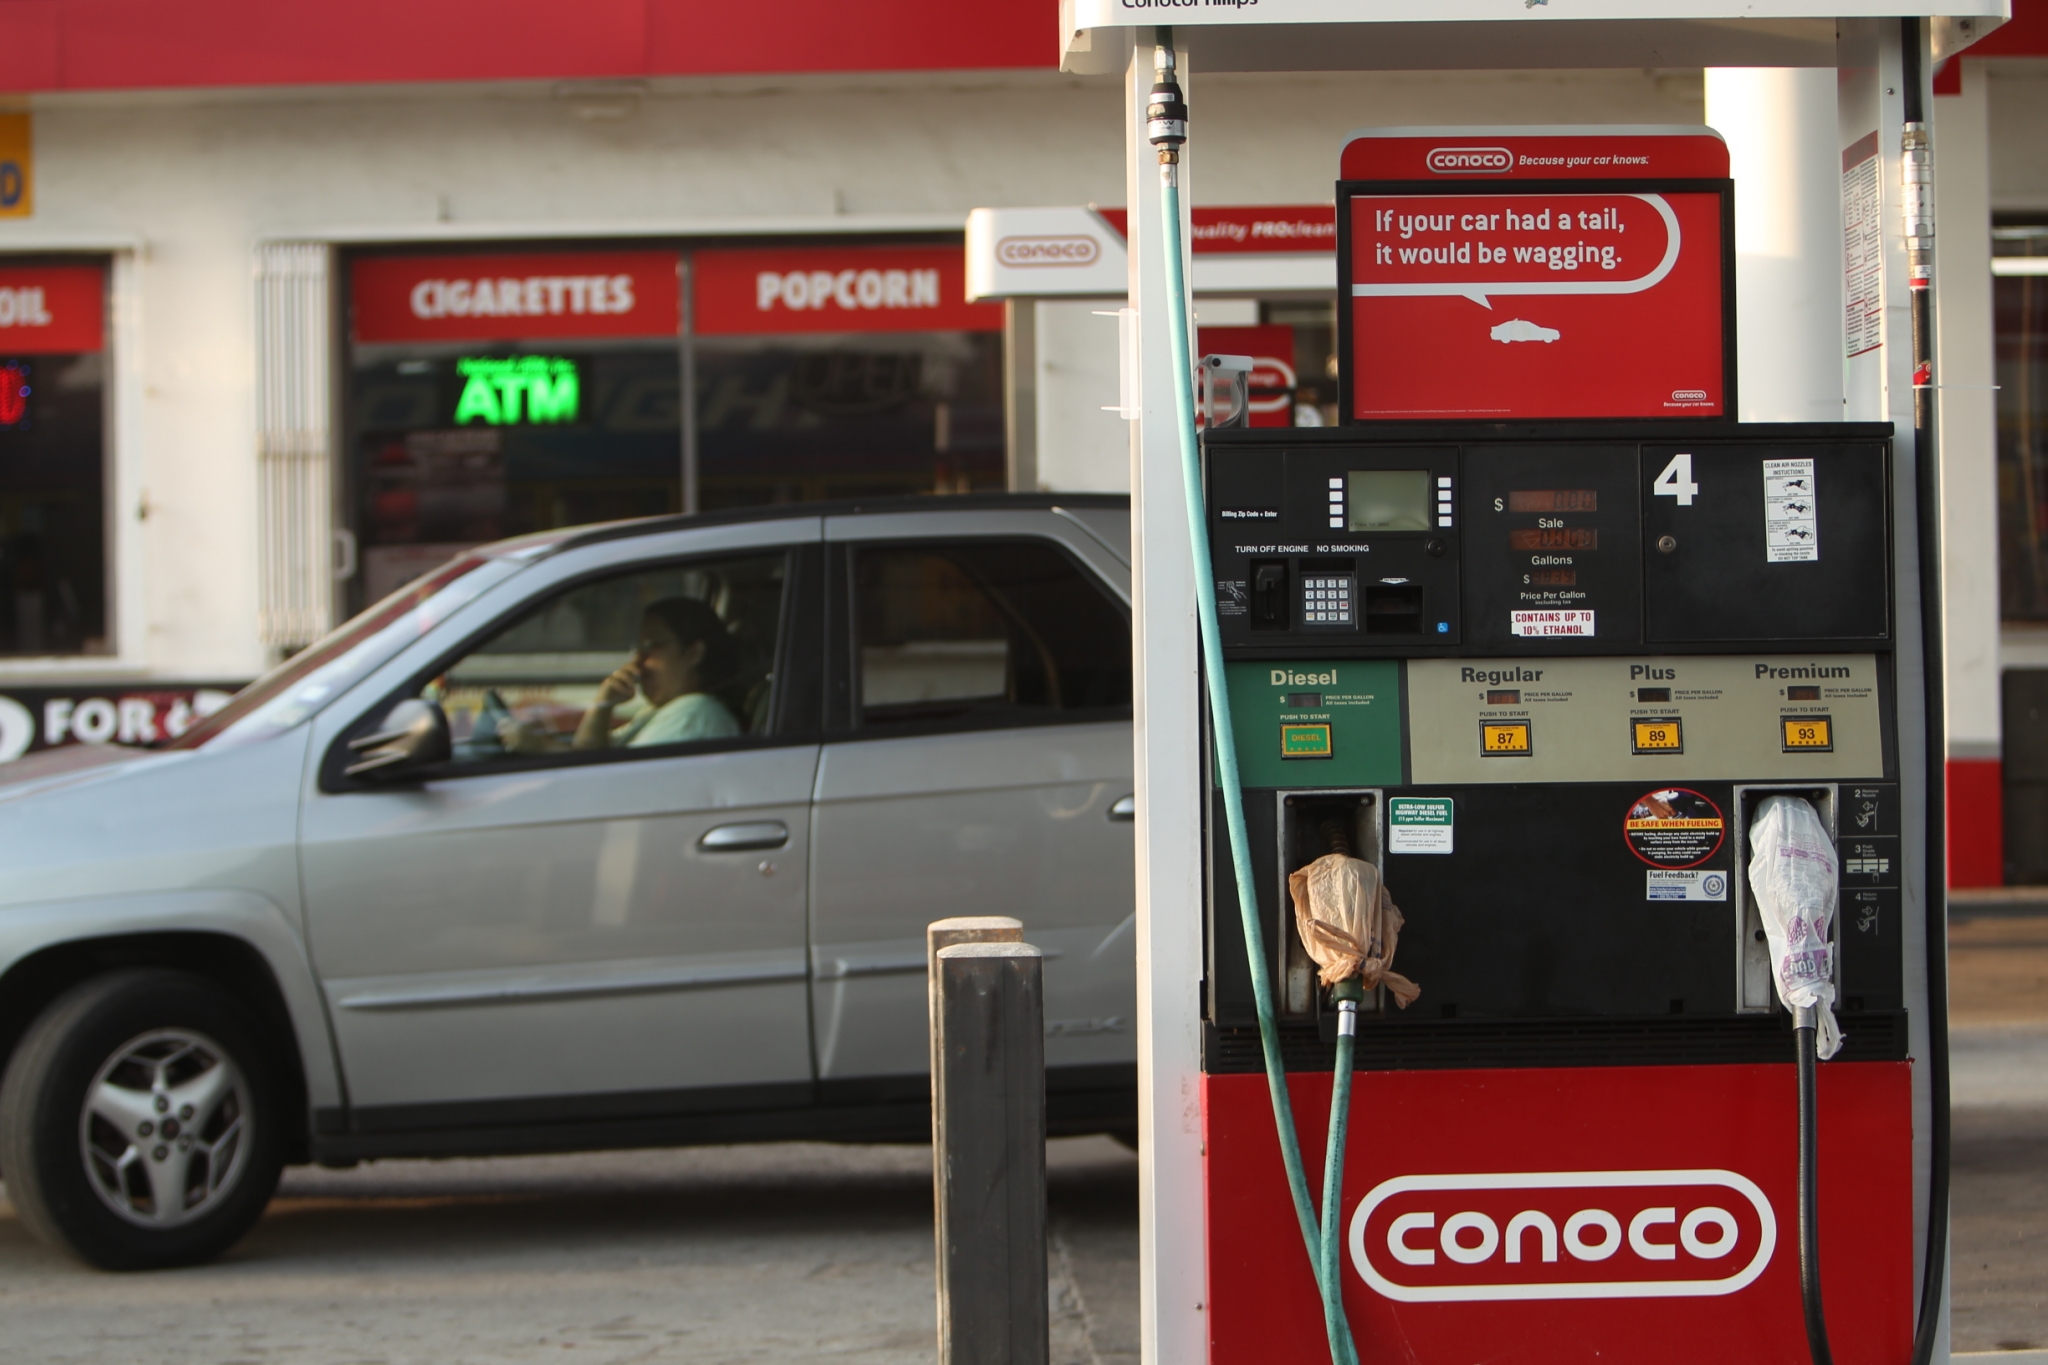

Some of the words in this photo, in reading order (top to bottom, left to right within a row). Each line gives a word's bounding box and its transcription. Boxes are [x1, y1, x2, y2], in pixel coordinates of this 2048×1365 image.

[1519, 155, 1564, 166] Because
[1567, 156, 1592, 168] your
[1594, 156, 1611, 165] car
[1613, 155, 1649, 165] knows.
[1376, 210, 1394, 232] If
[1399, 214, 1454, 239] your
[1460, 214, 1500, 232] car
[1506, 208, 1550, 231] had
[1558, 213, 1571, 230] a
[1578, 208, 1625, 234] tail,
[1191, 221, 1248, 242] uality
[1376, 242, 1392, 265] it
[1399, 242, 1470, 264] would
[1478, 242, 1506, 264] be
[1513, 240, 1622, 270] wagging.
[756, 269, 938, 310] POPCORN
[410, 274, 636, 319] CIGARETTES
[453, 373, 579, 425] ATM
[1654, 454, 1698, 506] 4
[1538, 518, 1564, 528] Sale
[1278, 545, 1309, 553] ENGINE
[1532, 556, 1573, 565] Gallons
[1520, 592, 1541, 600] Price
[1559, 591, 1586, 599] Gallon
[1516, 613, 1560, 623] CONTAINS
[1564, 612, 1576, 622] UP
[1580, 612, 1591, 622] TO
[1523, 626, 1540, 635] 10%
[1544, 625, 1584, 634] ETHANOL
[1462, 667, 1543, 686] Regular
[1630, 665, 1676, 680] Plus
[1755, 663, 1850, 679] Premium
[1271, 669, 1337, 686] Diesel
[1280, 696, 1285, 704] $
[44, 698, 156, 744] FOR
[1292, 734, 1321, 742] DIESEL
[1498, 733, 1514, 744] 87
[1649, 730, 1666, 742] 89
[1798, 728, 1815, 740] 93
[1855, 789, 1860, 798] 2
[1855, 845, 1861, 854] 3
[1855, 893, 1861, 901] 4
[1387, 1206, 1739, 1265] conoco
